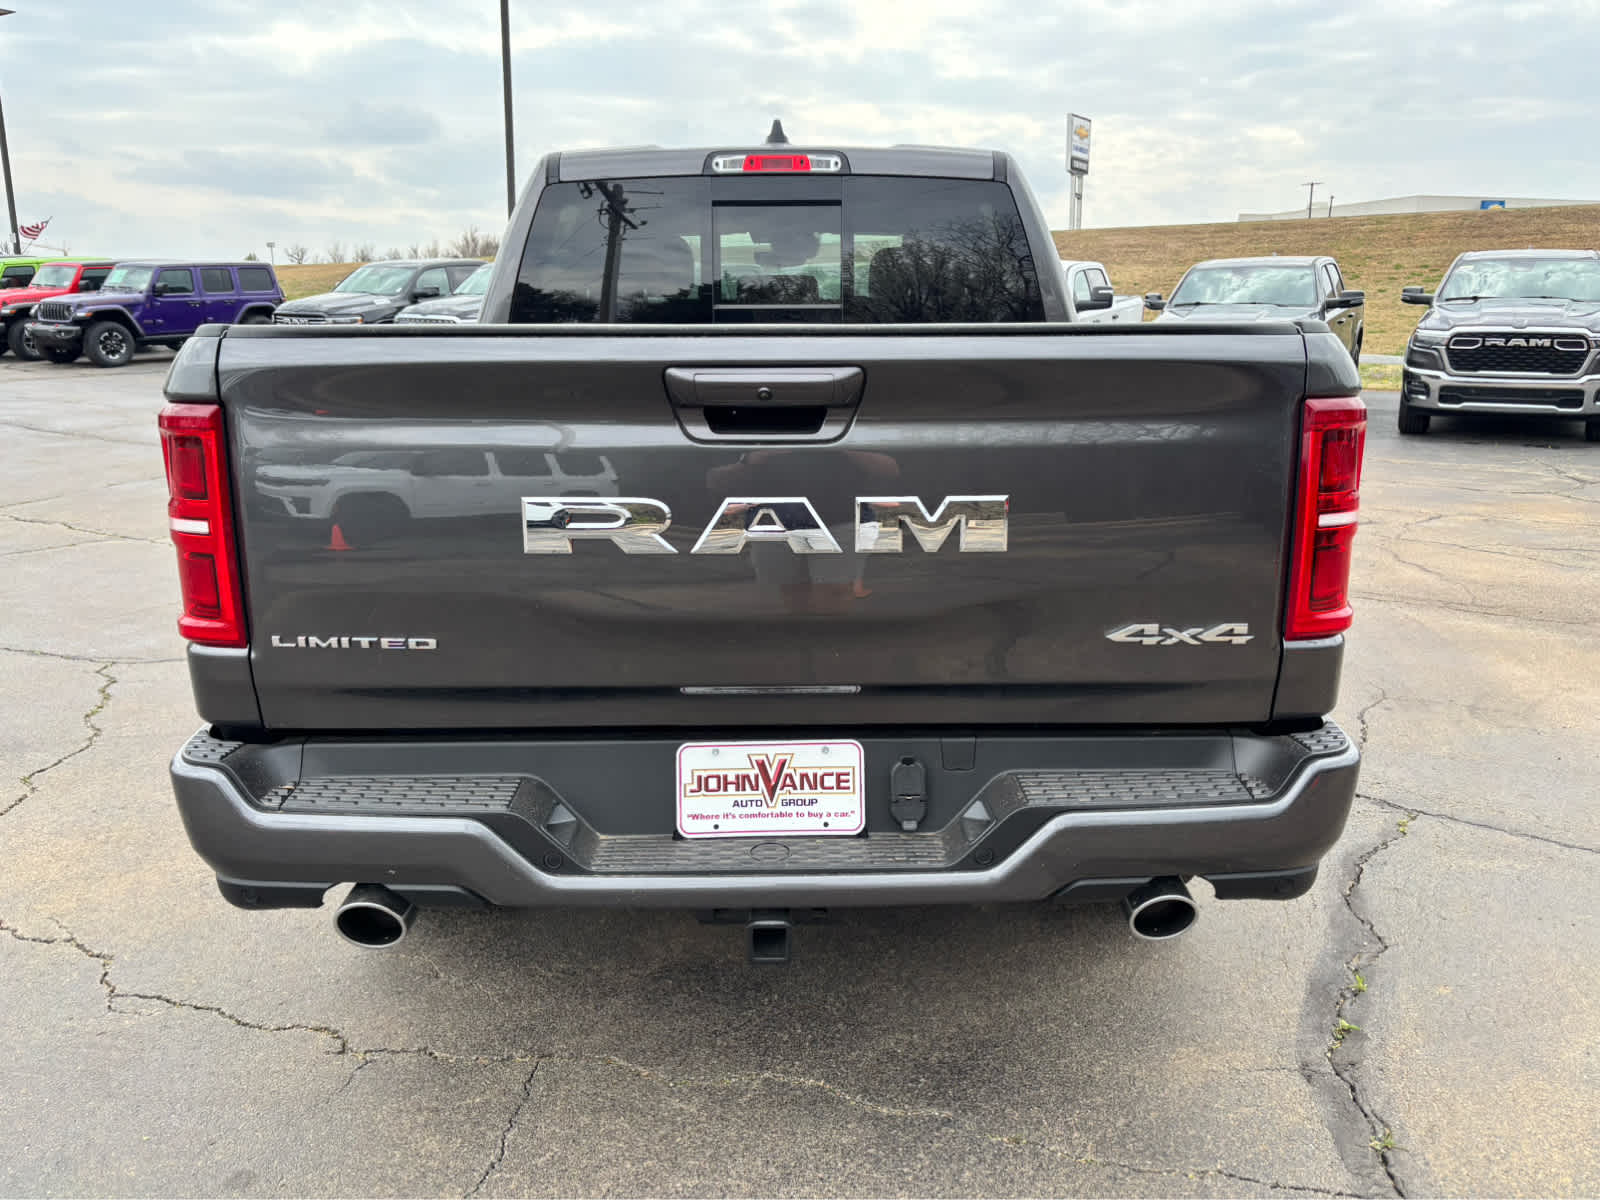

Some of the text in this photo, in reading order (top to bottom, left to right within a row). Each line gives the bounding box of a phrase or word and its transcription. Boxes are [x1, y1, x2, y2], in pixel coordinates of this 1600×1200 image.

[1484, 338, 1552, 347] RAM
[521, 495, 1009, 555] RAM
[271, 635, 437, 650] LIMITED
[689, 758, 851, 802] JOHN VANCE
[732, 798, 818, 808] AUTO GROUP
[738, 811, 793, 819] comfortable
[808, 811, 823, 819] buy
